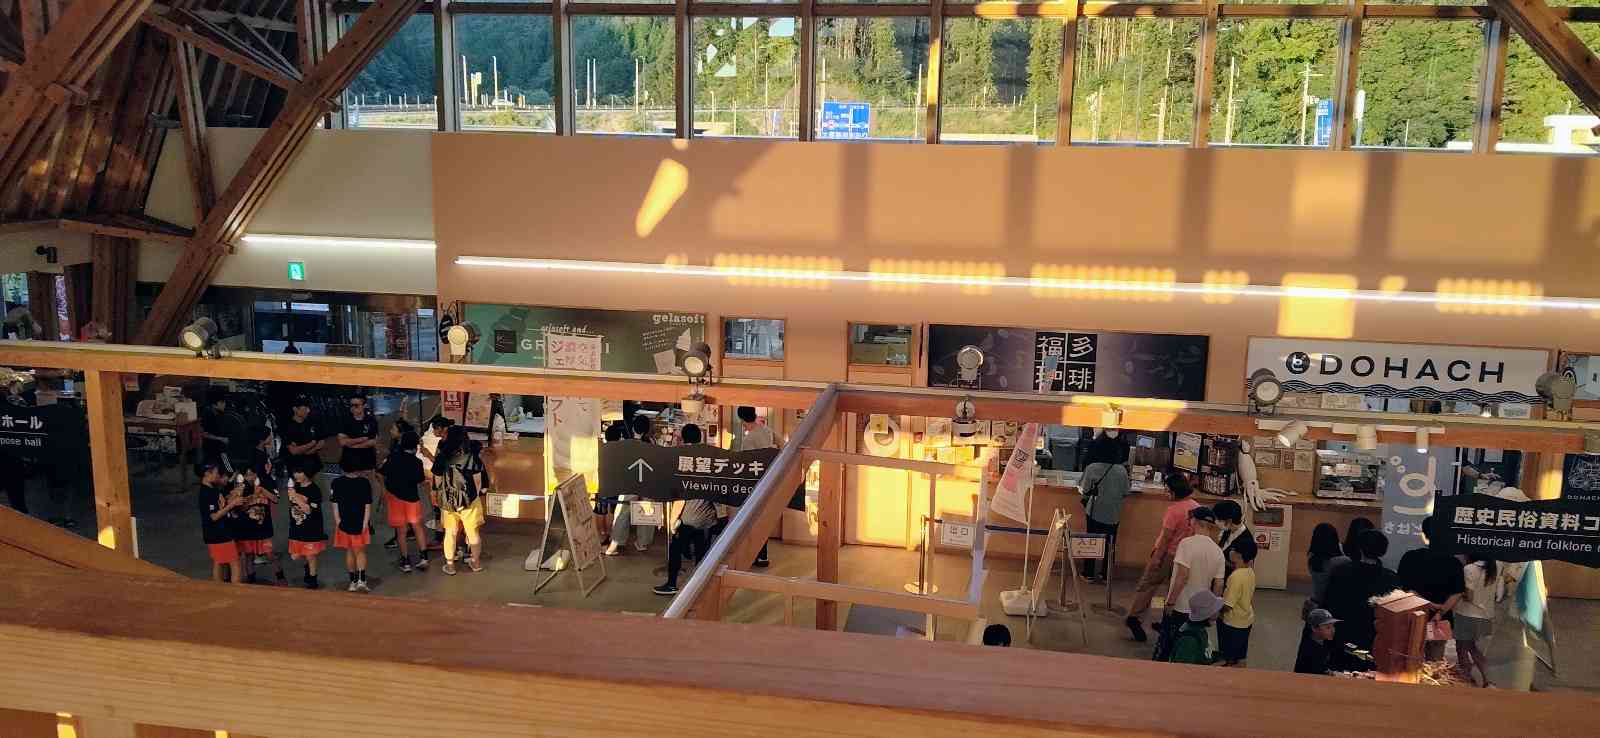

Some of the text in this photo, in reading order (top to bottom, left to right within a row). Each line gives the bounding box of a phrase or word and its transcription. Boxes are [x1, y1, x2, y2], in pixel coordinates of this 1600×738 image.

[1319, 354, 1505, 383] DOHACH
[1, 414, 43, 429] ホール
[677, 455, 765, 476] 展望デッキ
[682, 479, 754, 495] Viewing dec
[1454, 506, 1600, 531] 歴史民俗資料コ
[1456, 534, 1592, 553] Historical and folklore
